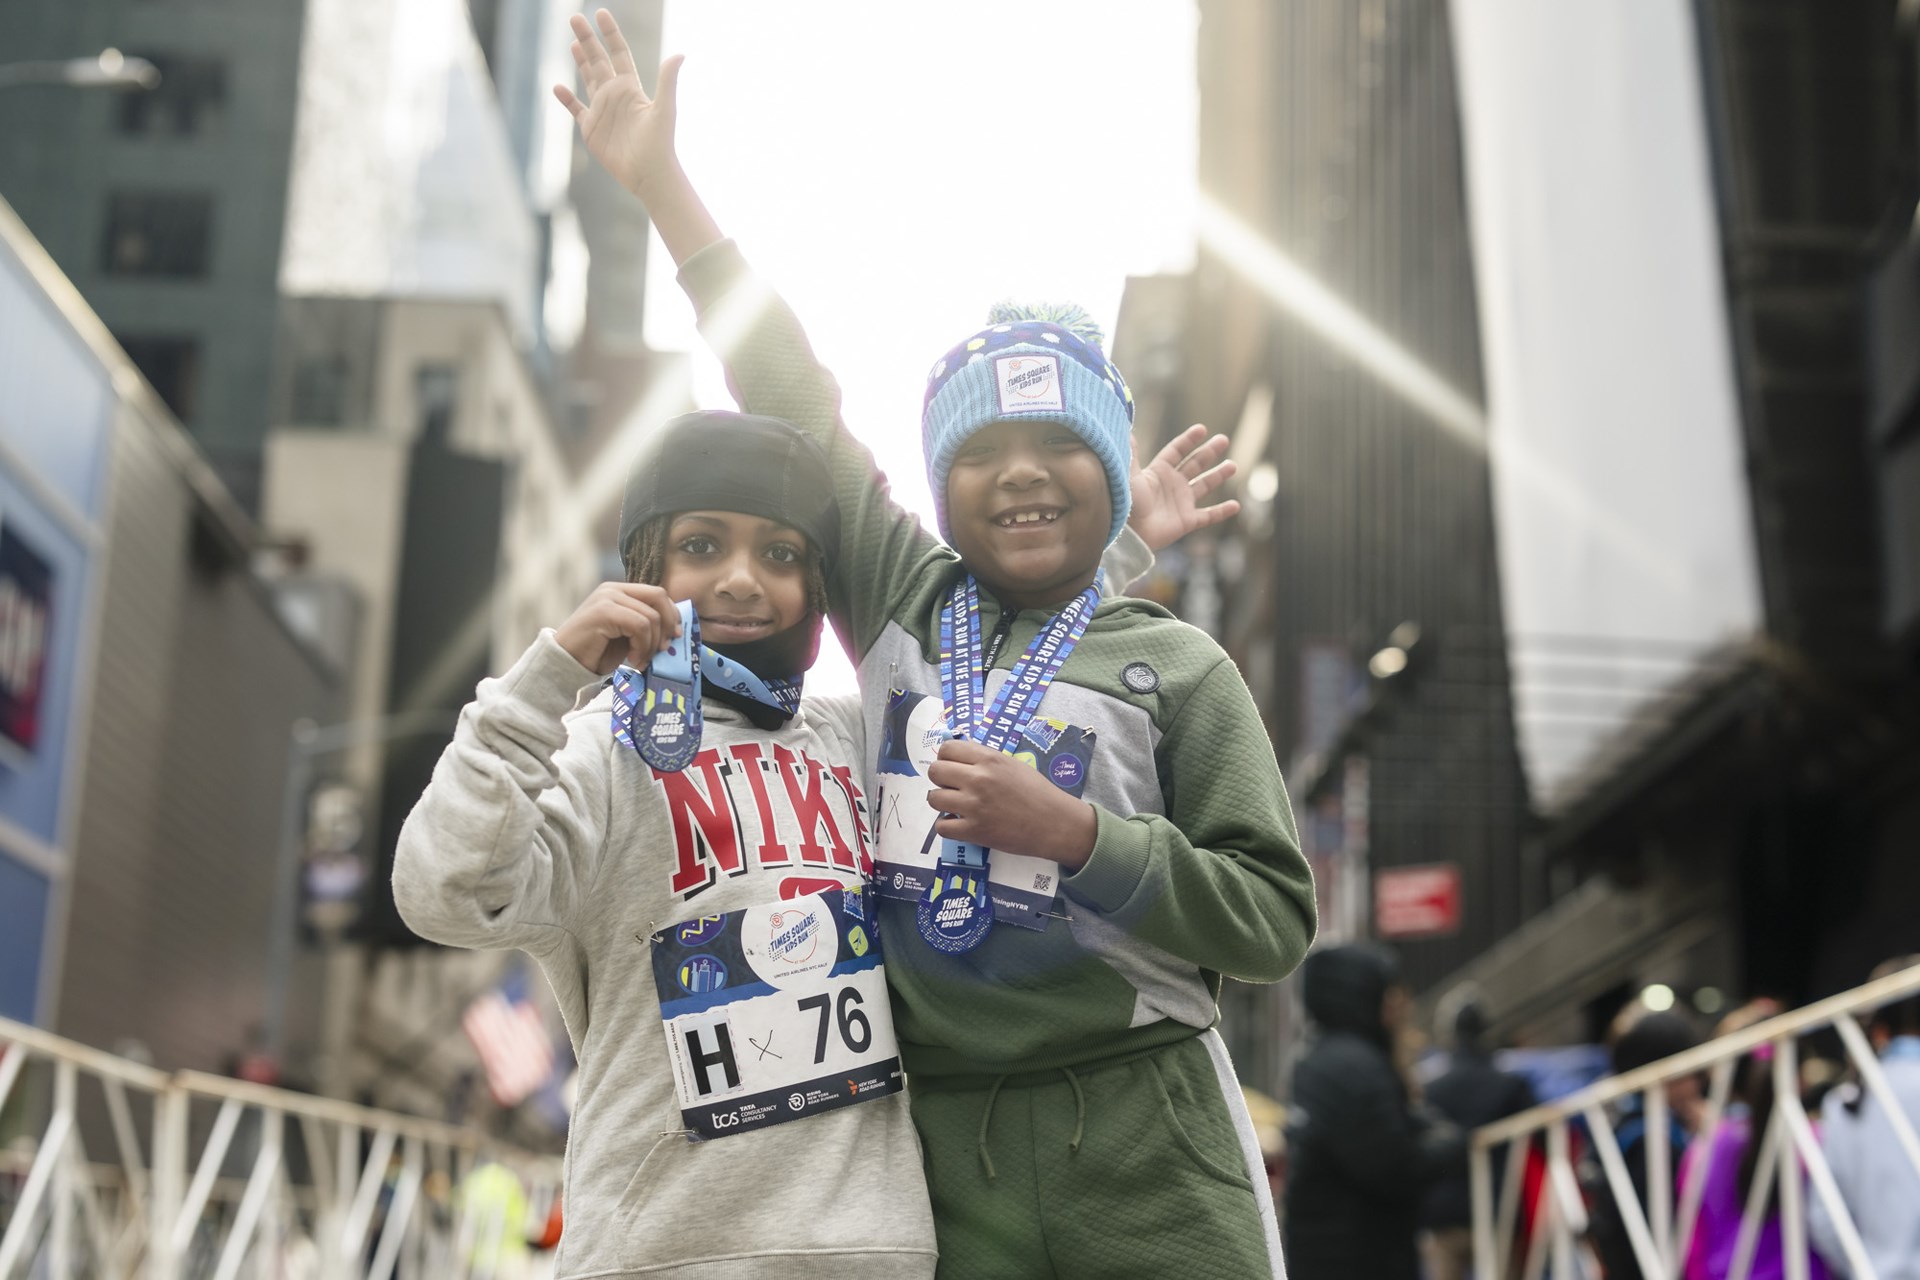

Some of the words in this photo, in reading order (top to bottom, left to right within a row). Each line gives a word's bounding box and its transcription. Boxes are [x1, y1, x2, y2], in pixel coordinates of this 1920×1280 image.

[1008, 373, 1027, 388] TIMES
[1027, 364, 1050, 380] SQUARE
[1019, 379, 1032, 390] KIDS
[1032, 375, 1042, 385] RUN
[954, 600, 968, 626] KIDS
[1060, 595, 1087, 624] TIMES
[955, 625, 969, 646] RUN
[1034, 621, 1069, 664] SQUARE
[955, 647, 969, 659] AT
[955, 660, 970, 681] THE
[1018, 664, 1043, 692] KIDS
[771, 689, 786, 703] AT
[782, 686, 800, 701] THE
[955, 682, 970, 719] UNITED
[1004, 692, 1028, 716] RUN
[656, 711, 681, 725] TIMES
[995, 716, 1013, 733] AT
[650, 722, 686, 737] SQUARE
[986, 734, 1004, 751] TH
[650, 742, 876, 902] NIKE
[941, 896, 971, 911] TIMES
[934, 906, 974, 923] SQUARE
[770, 930, 791, 952] TIMES
[791, 912, 815, 938] SQUARE
[785, 937, 798, 954] KIDS
[797, 929, 809, 945] RUN
[774, 971, 790, 979] UNITED
[790, 967, 809, 975] AIRLINES
[685, 1022, 741, 1096] H
[797, 986, 872, 1065] 76
[858, 1085, 870, 1093] ROAD
[869, 1080, 886, 1090] RUNNERS
[867, 1078, 878, 1086] YORK
[739, 1103, 756, 1112] TATA
[740, 1104, 777, 1118] CONSULTANCY
[711, 1111, 740, 1129] tcs
[741, 1113, 766, 1124] SERVICES
